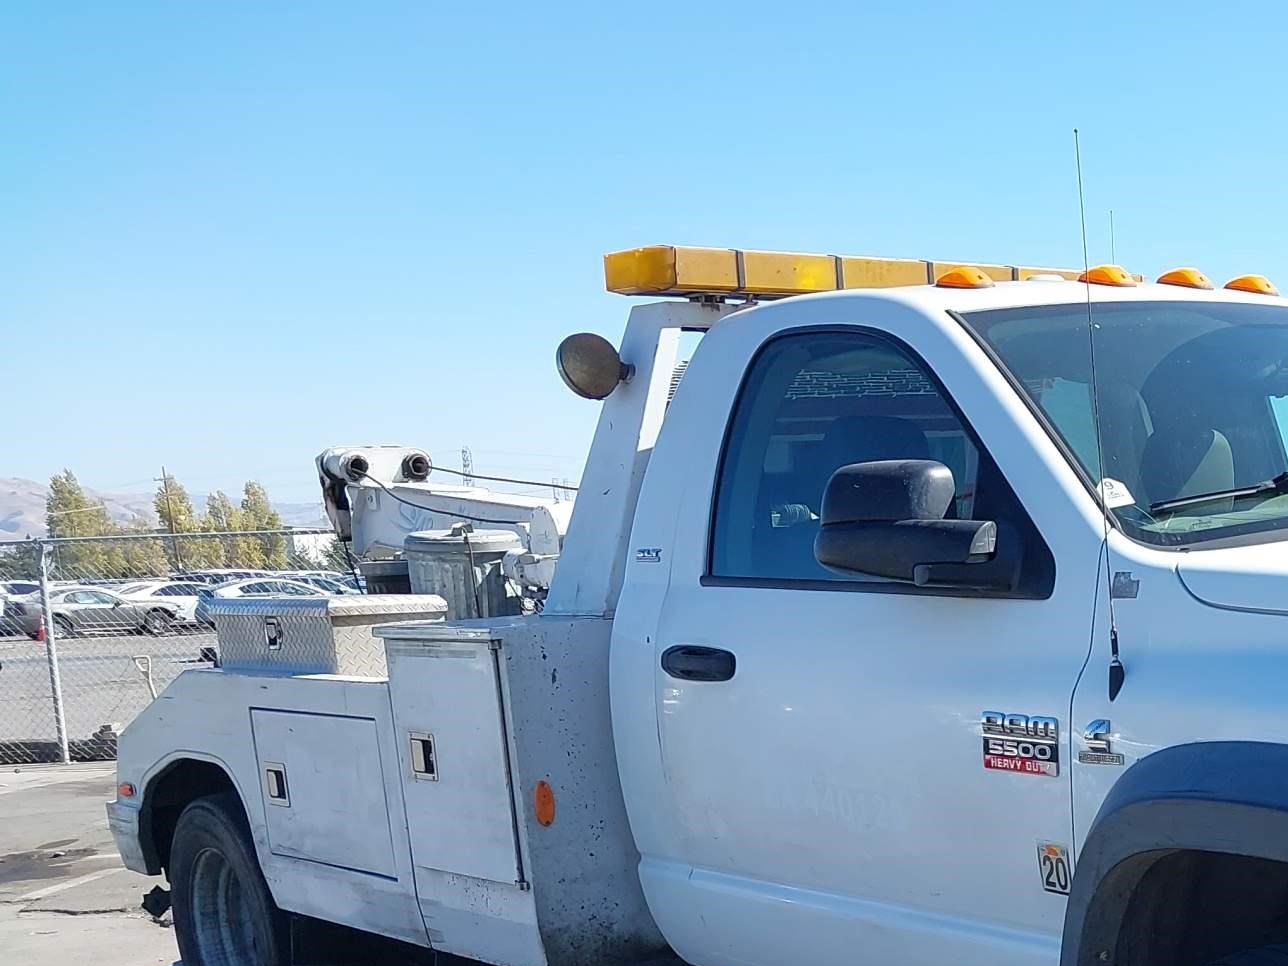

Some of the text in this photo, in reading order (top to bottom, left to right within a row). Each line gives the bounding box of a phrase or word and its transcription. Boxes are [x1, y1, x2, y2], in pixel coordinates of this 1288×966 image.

[636, 548, 662, 557] SLT
[982, 711, 1057, 737] RAM
[988, 740, 1052, 760] 5500
[990, 757, 1051, 773] HEAVY DU
[1042, 855, 1068, 890] 20
